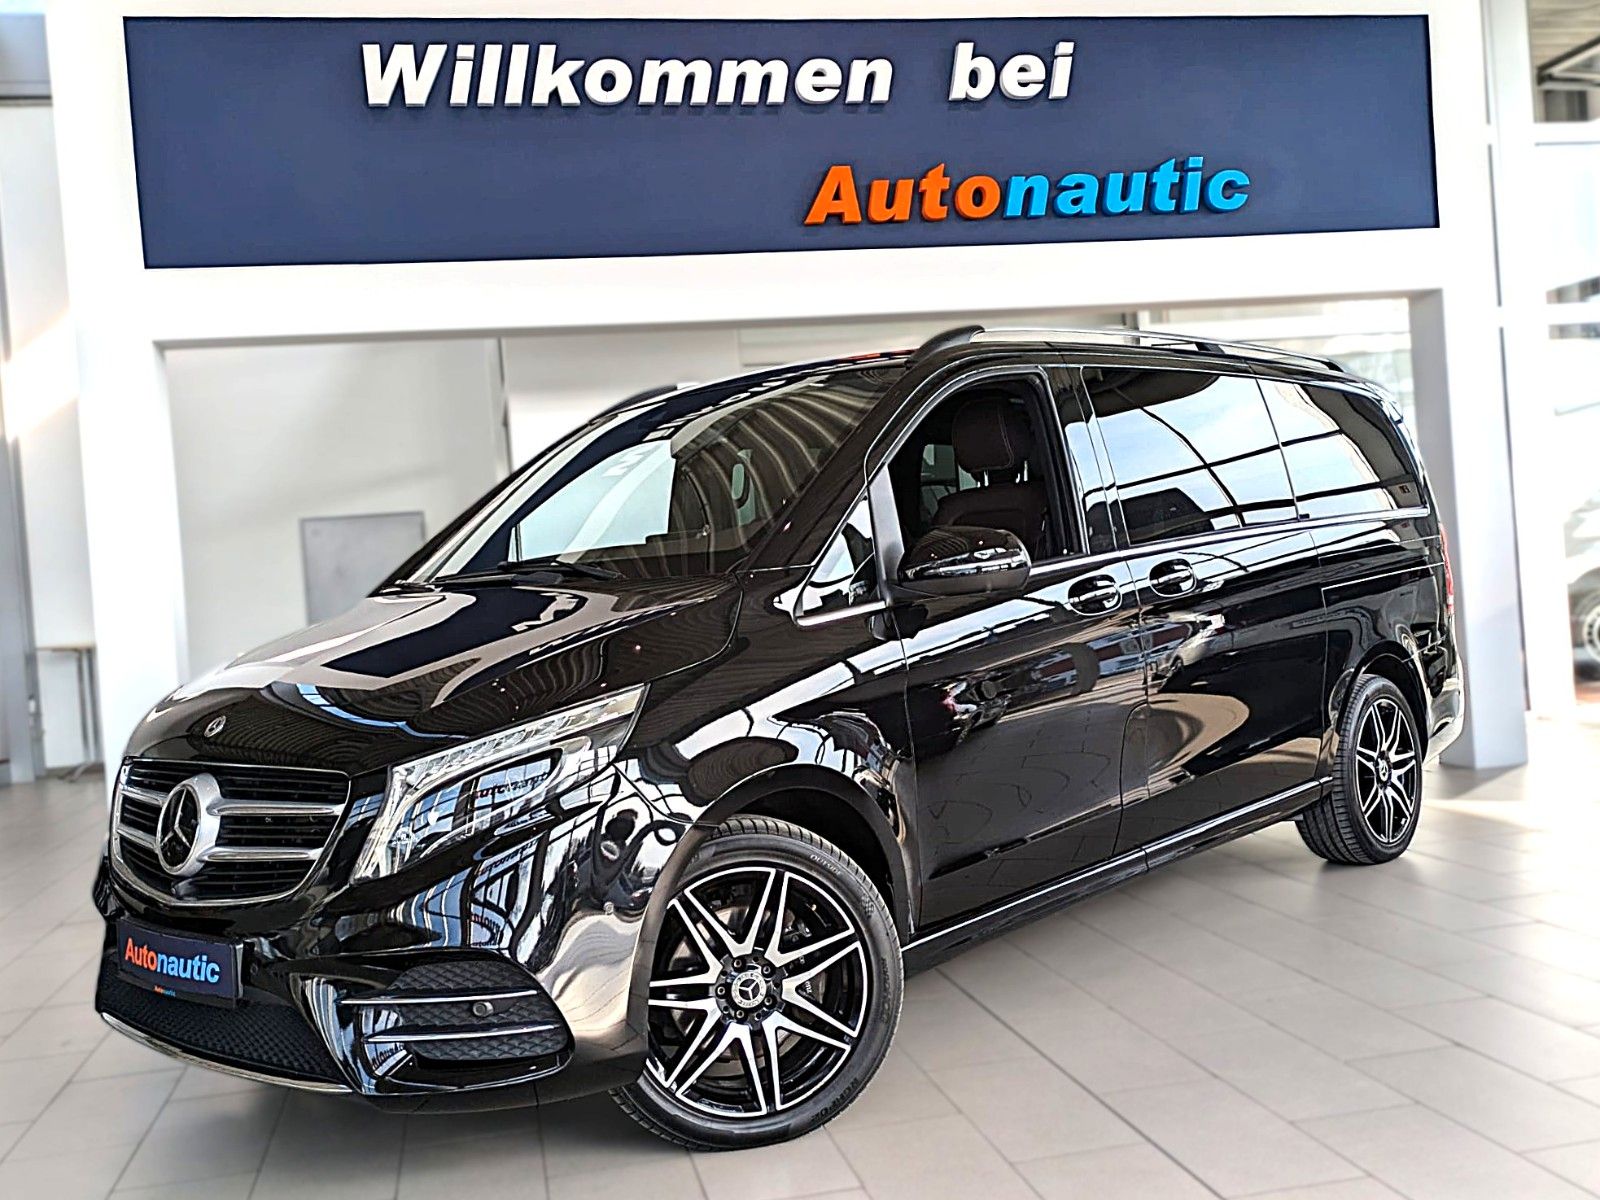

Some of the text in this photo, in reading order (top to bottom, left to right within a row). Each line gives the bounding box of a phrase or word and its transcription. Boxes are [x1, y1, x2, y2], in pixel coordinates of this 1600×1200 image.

[362, 41, 1075, 107] Willkommen bei
[806, 157, 1250, 224] Autonautic
[125, 937, 220, 983] Autonautic
